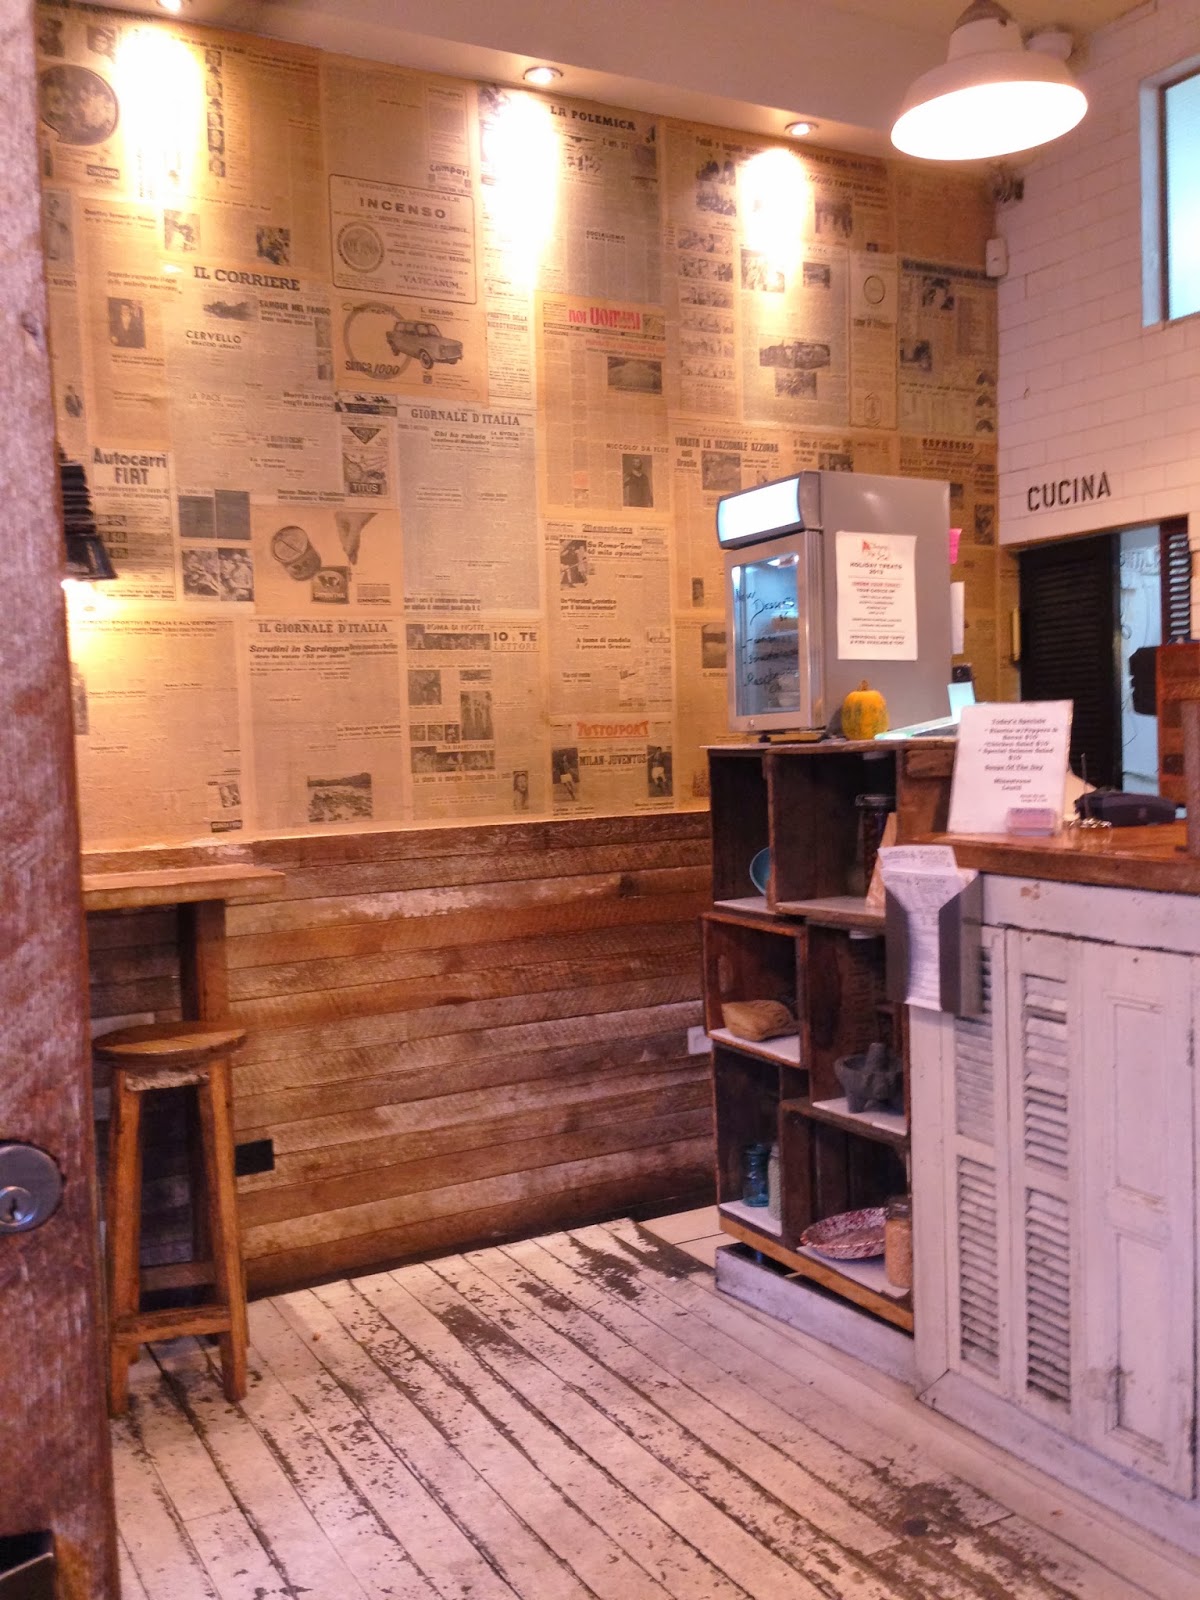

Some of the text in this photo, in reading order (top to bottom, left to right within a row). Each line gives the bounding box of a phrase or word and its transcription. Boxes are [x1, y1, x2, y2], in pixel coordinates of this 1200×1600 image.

[572, 110, 636, 131] POLEMICA
[360, 197, 446, 219] INCENSO
[193, 266, 300, 291] IL CORRIERE
[186, 330, 242, 344] CERVELLO
[411, 409, 468, 423] GIORNALE
[94, 447, 167, 468] Autocarri
[115, 467, 149, 485] FIAT
[352, 483, 379, 493] TITUS
[1027, 471, 1111, 512] CUCINA
[258, 623, 272, 633] IL
[275, 623, 334, 634] GIORNALE
[493, 632, 509, 642] IO
[520, 632, 538, 642] TE
[576, 720, 649, 736] TUTTOSPORT
